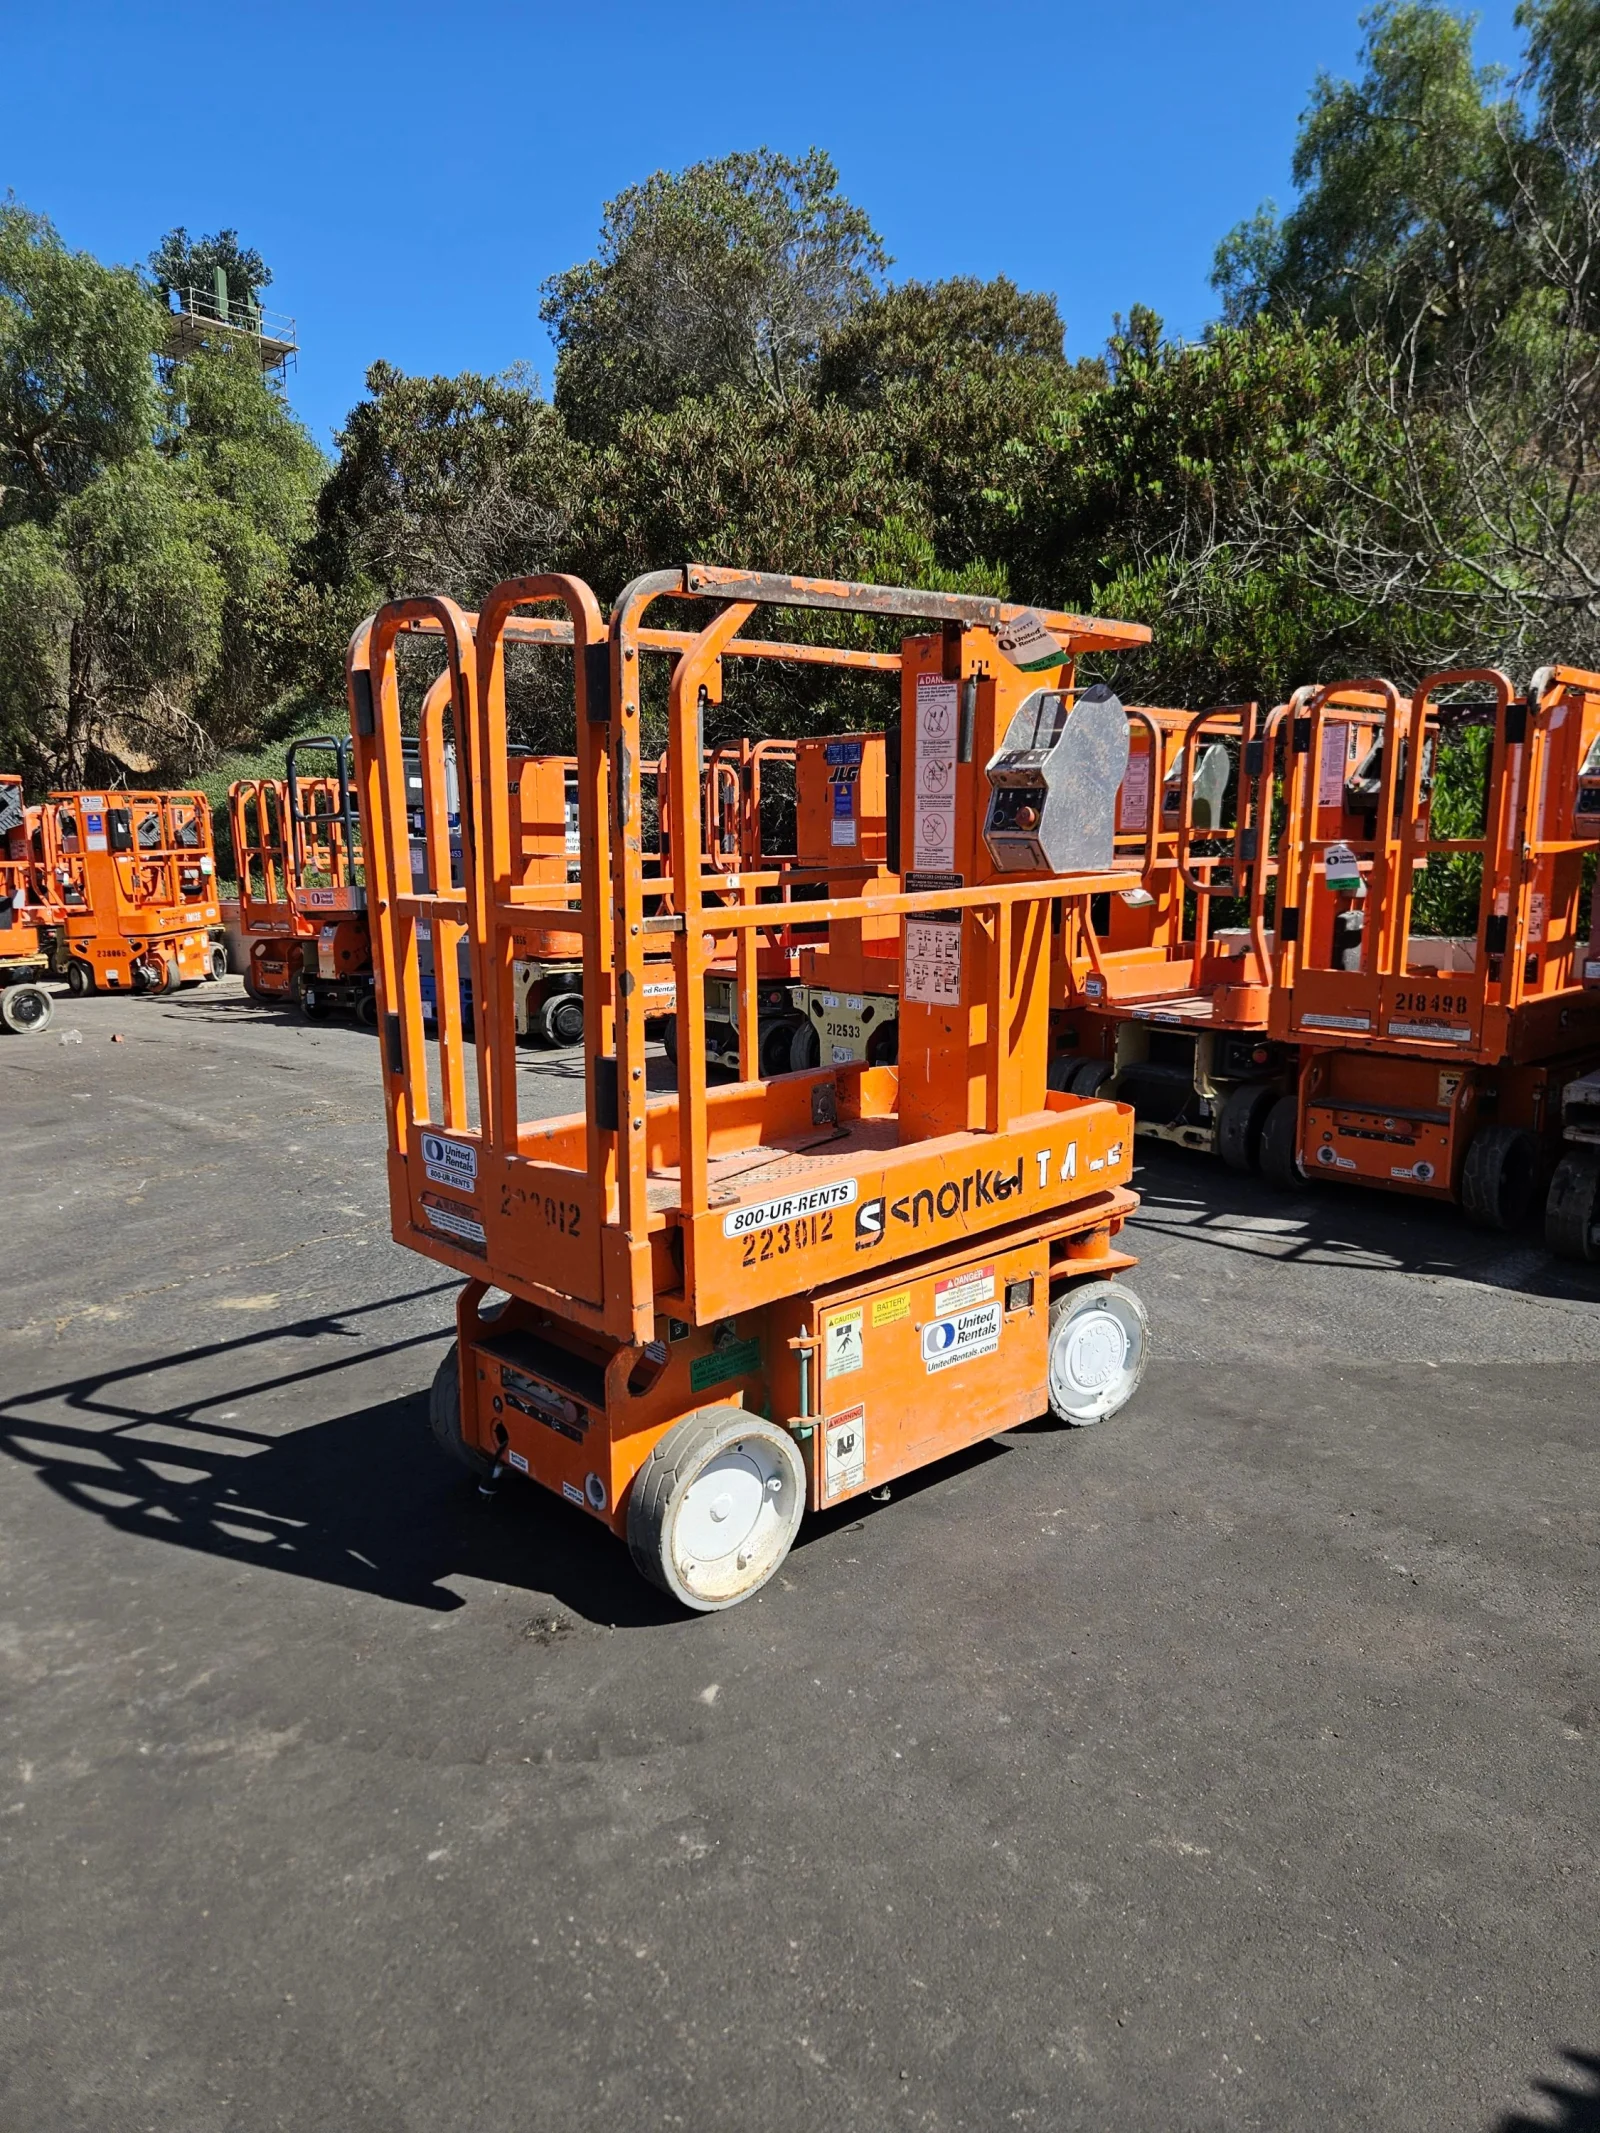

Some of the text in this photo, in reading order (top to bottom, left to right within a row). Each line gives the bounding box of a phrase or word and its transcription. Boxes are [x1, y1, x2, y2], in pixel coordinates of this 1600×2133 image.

[1014, 627, 1041, 643] United
[1018, 632, 1047, 647] Rentals
[827, 766, 859, 783] JLG
[654, 985, 676, 994] Rental
[1395, 993, 1467, 1014] 218498
[827, 1023, 860, 1038] 212533
[445, 1145, 470, 1161] United
[445, 1155, 473, 1172] Rentals
[430, 1169, 471, 1188] 800-UR-RENTS
[734, 1185, 849, 1230] 800-UR-RENTS
[742, 1210, 833, 1267] 223012
[954, 1269, 983, 1286] DANGER
[876, 1296, 906, 1312] BATTERY
[834, 1311, 861, 1325] CAUTION
[957, 1308, 995, 1331] United
[957, 1323, 997, 1345] Rentals
[927, 1342, 997, 1372] UnitedRentals.com
[833, 1408, 863, 1425] WARNING
